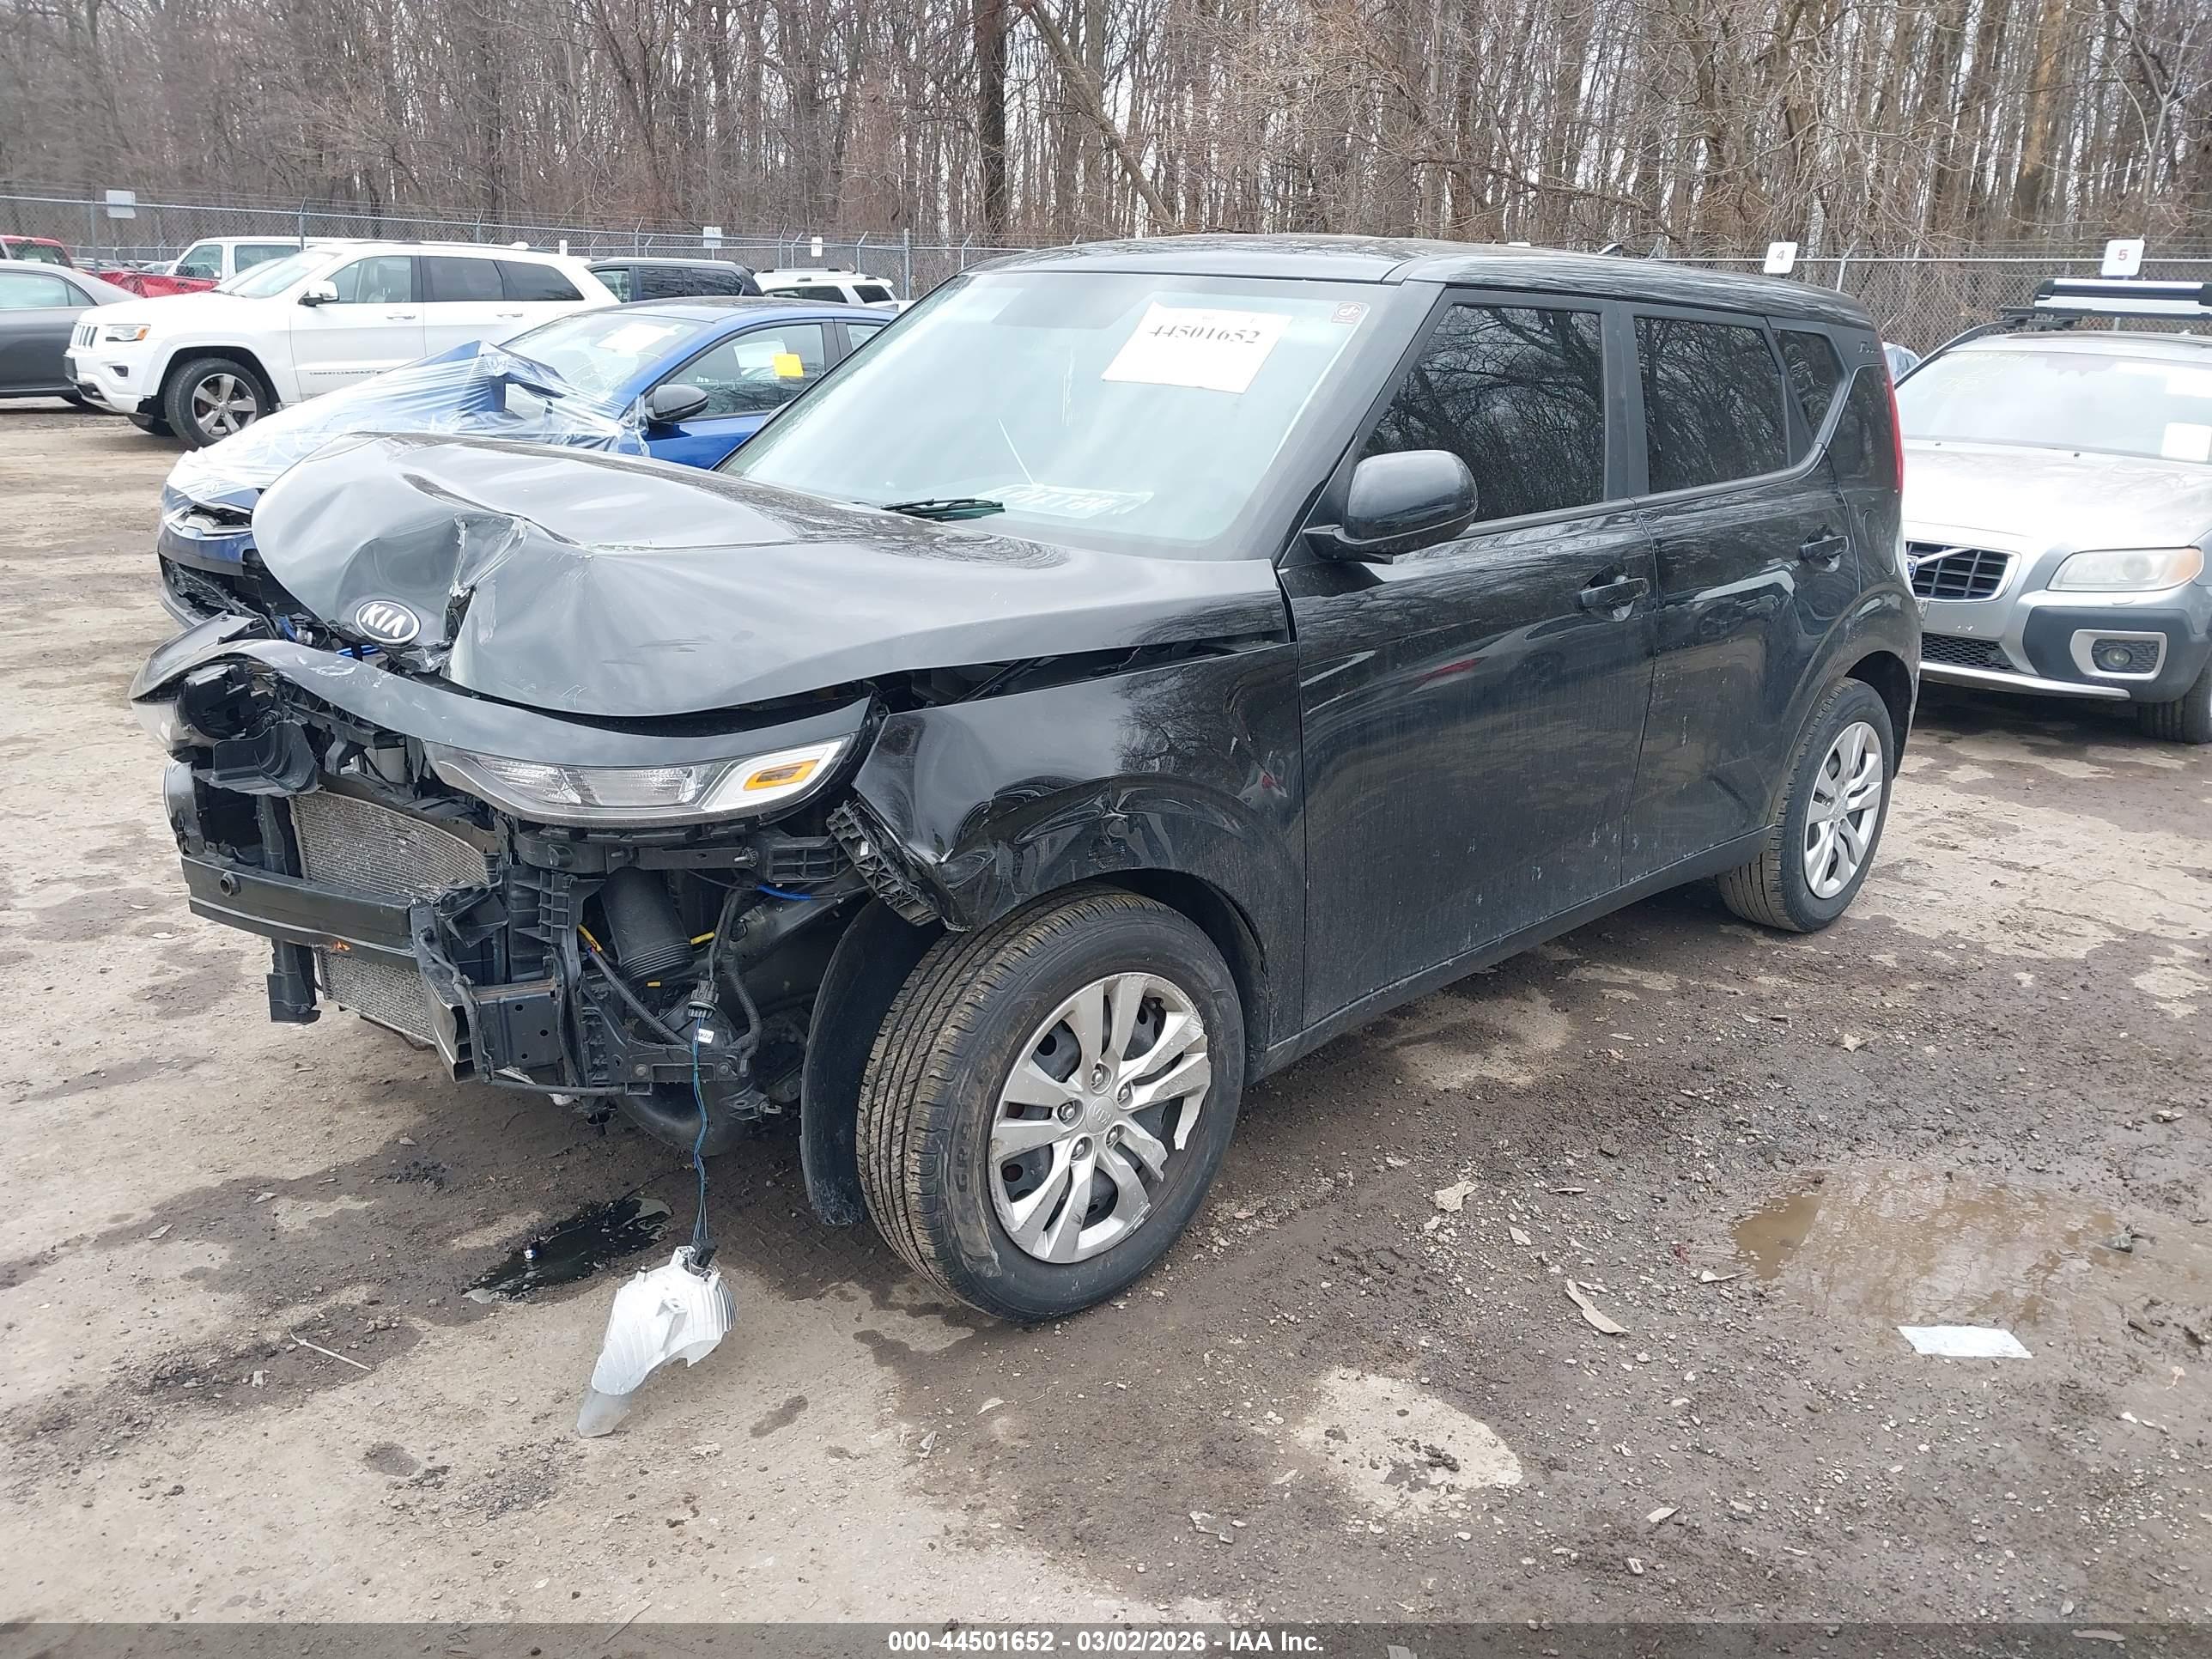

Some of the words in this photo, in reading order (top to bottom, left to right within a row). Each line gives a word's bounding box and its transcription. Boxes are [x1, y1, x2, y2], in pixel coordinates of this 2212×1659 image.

[1776, 250, 1785, 260] 4
[2118, 248, 2129, 261] 5
[1147, 325, 1261, 343] 44501652
[361, 603, 407, 638] KIA
